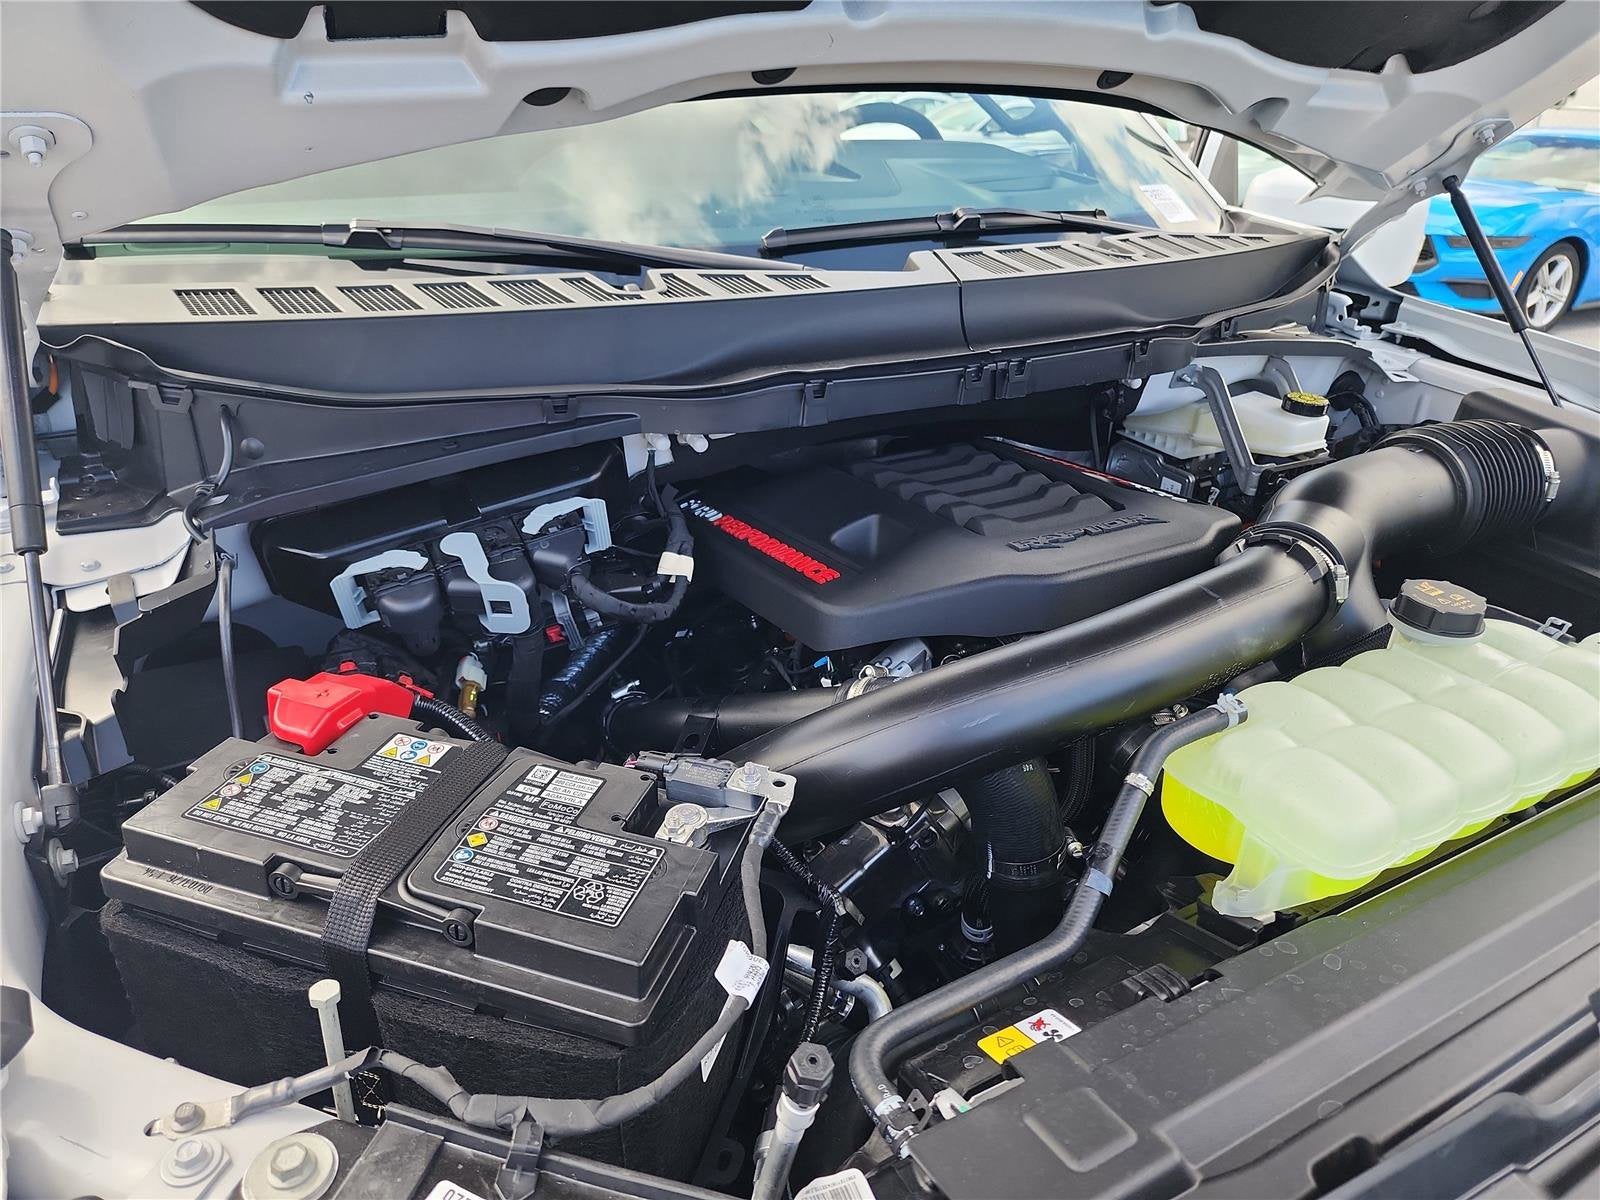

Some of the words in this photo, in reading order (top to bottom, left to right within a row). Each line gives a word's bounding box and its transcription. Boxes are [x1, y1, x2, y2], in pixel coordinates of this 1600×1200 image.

[1006, 513, 1170, 552] RAPTOR
[523, 795, 541, 804] MF
[542, 801, 578, 814] FoMoCo
[499, 811, 551, 830] DANGER/POISON
[564, 828, 617, 846] PELIGRO/VENENO
